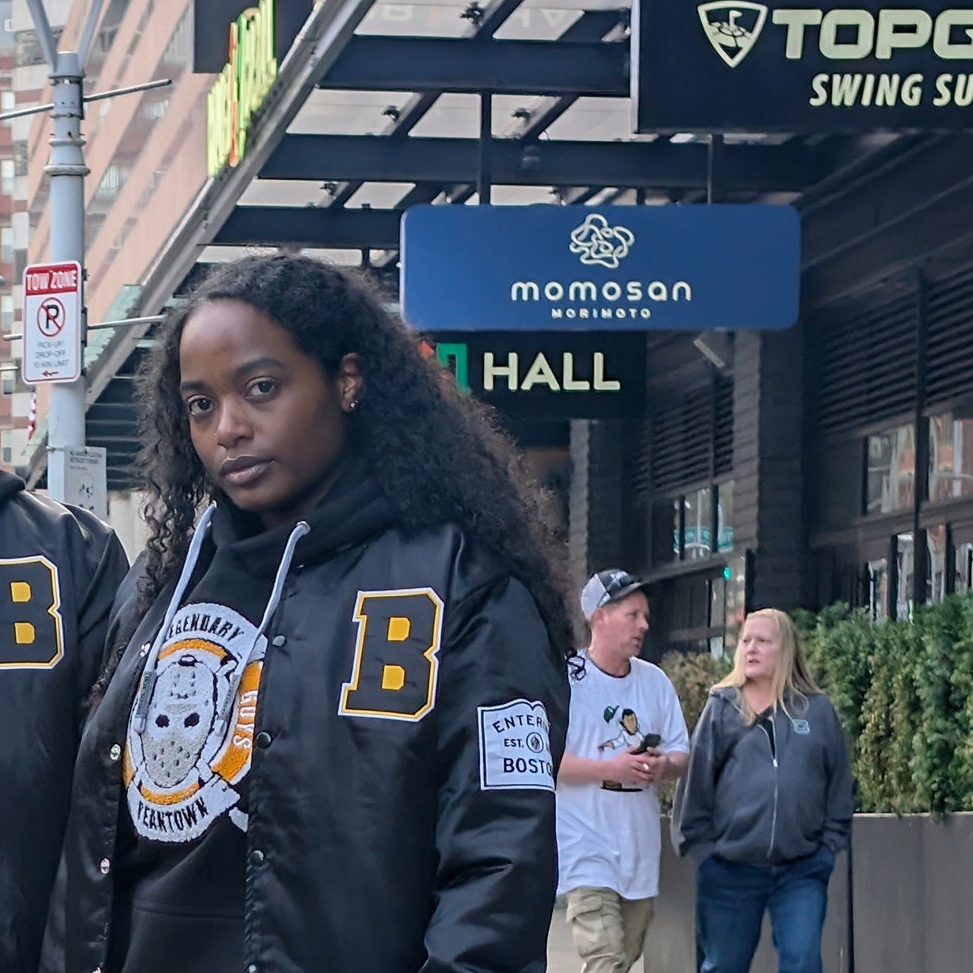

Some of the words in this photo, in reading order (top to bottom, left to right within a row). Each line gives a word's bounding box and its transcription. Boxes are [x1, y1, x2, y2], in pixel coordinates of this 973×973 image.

[809, 73, 925, 106] SWING
[27, 273, 49, 291] TOW
[50, 270, 77, 289] ZONE
[510, 281, 692, 301] momosan
[551, 308, 652, 319] MORIMOTO
[483, 352, 621, 391] HALL
[166, 613, 245, 642] EGENDARY
[338, 587, 444, 722] B
[492, 714, 548, 733] ENTER
[504, 738, 524, 748] EST.
